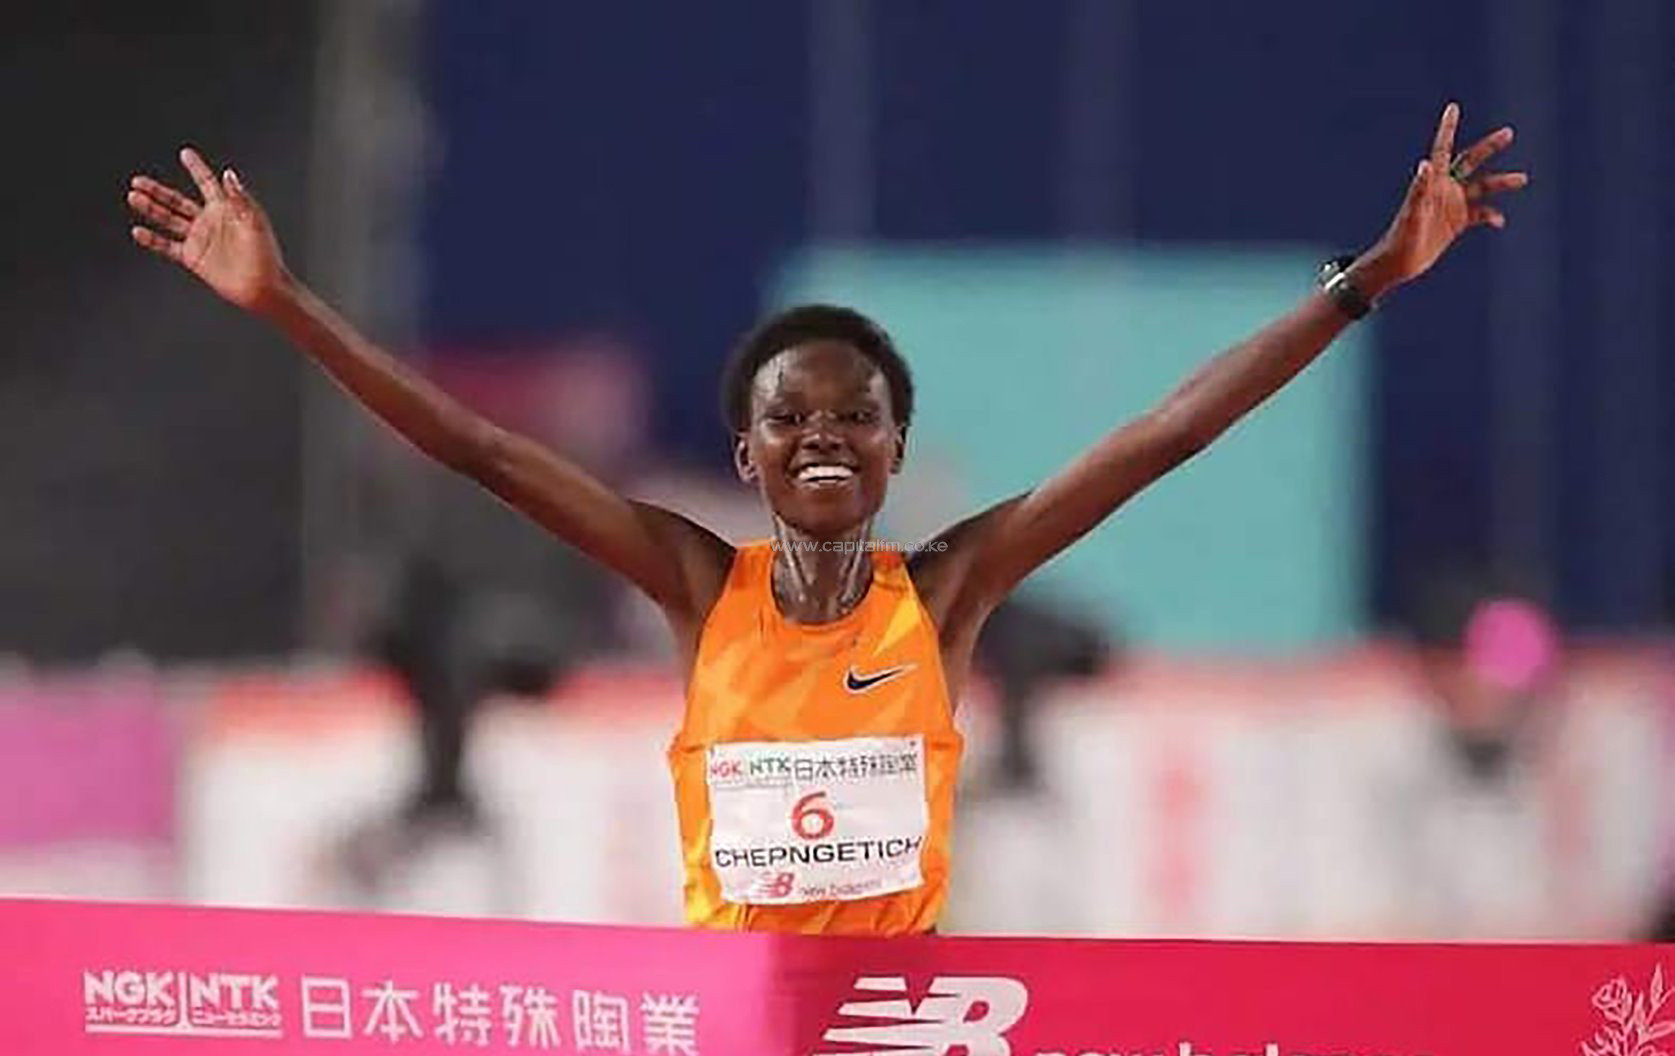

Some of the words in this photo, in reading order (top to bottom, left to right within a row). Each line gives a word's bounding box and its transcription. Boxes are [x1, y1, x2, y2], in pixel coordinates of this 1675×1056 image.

[791, 791, 834, 841] 6
[715, 836, 922, 868] CHEPNGETICH
[83, 970, 175, 1006] NGK
[190, 972, 279, 1010] NTK
[300, 976, 700, 1056] 日本特殊陶業
